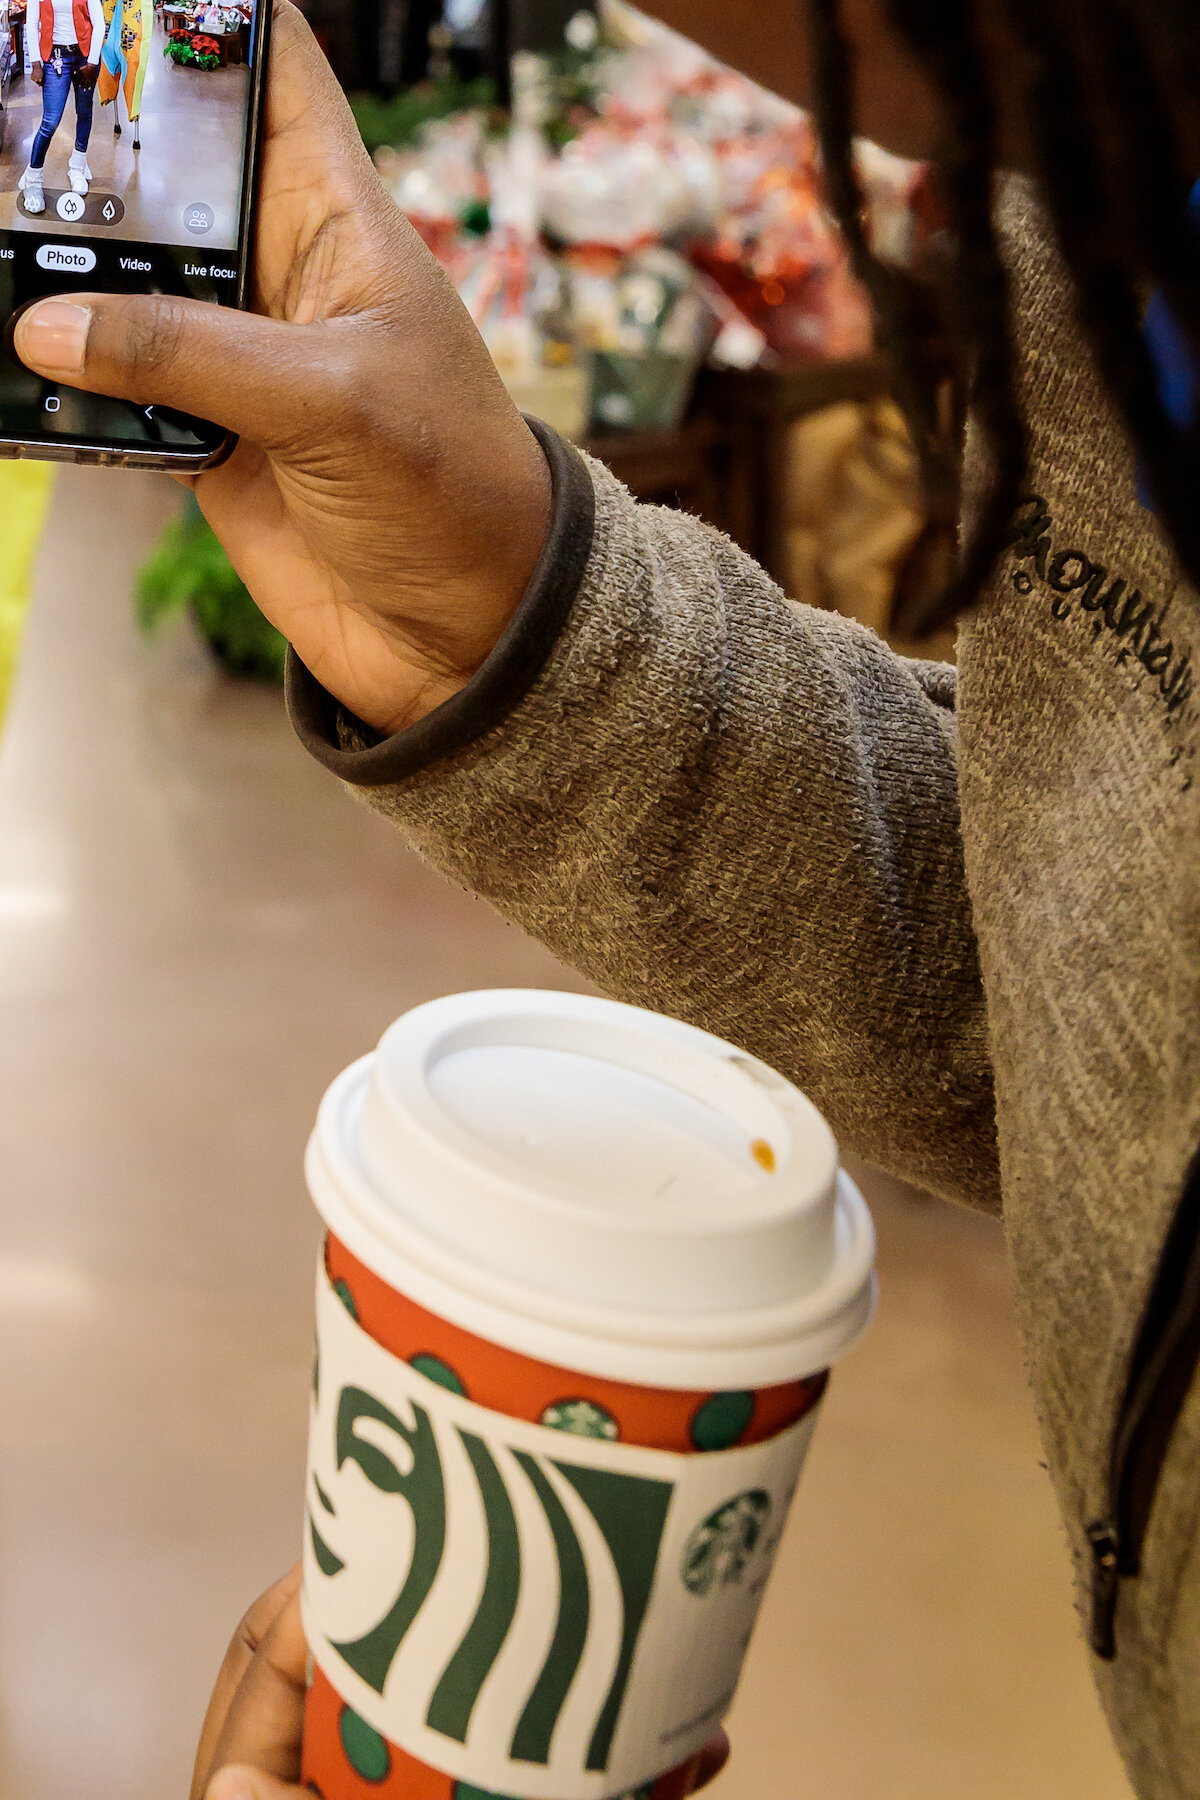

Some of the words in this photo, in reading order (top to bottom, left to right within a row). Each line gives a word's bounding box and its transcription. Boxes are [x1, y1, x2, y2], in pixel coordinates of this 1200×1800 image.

[46, 250, 87, 266] Photo
[119, 257, 152, 272] Video
[184, 263, 207, 277] Live
